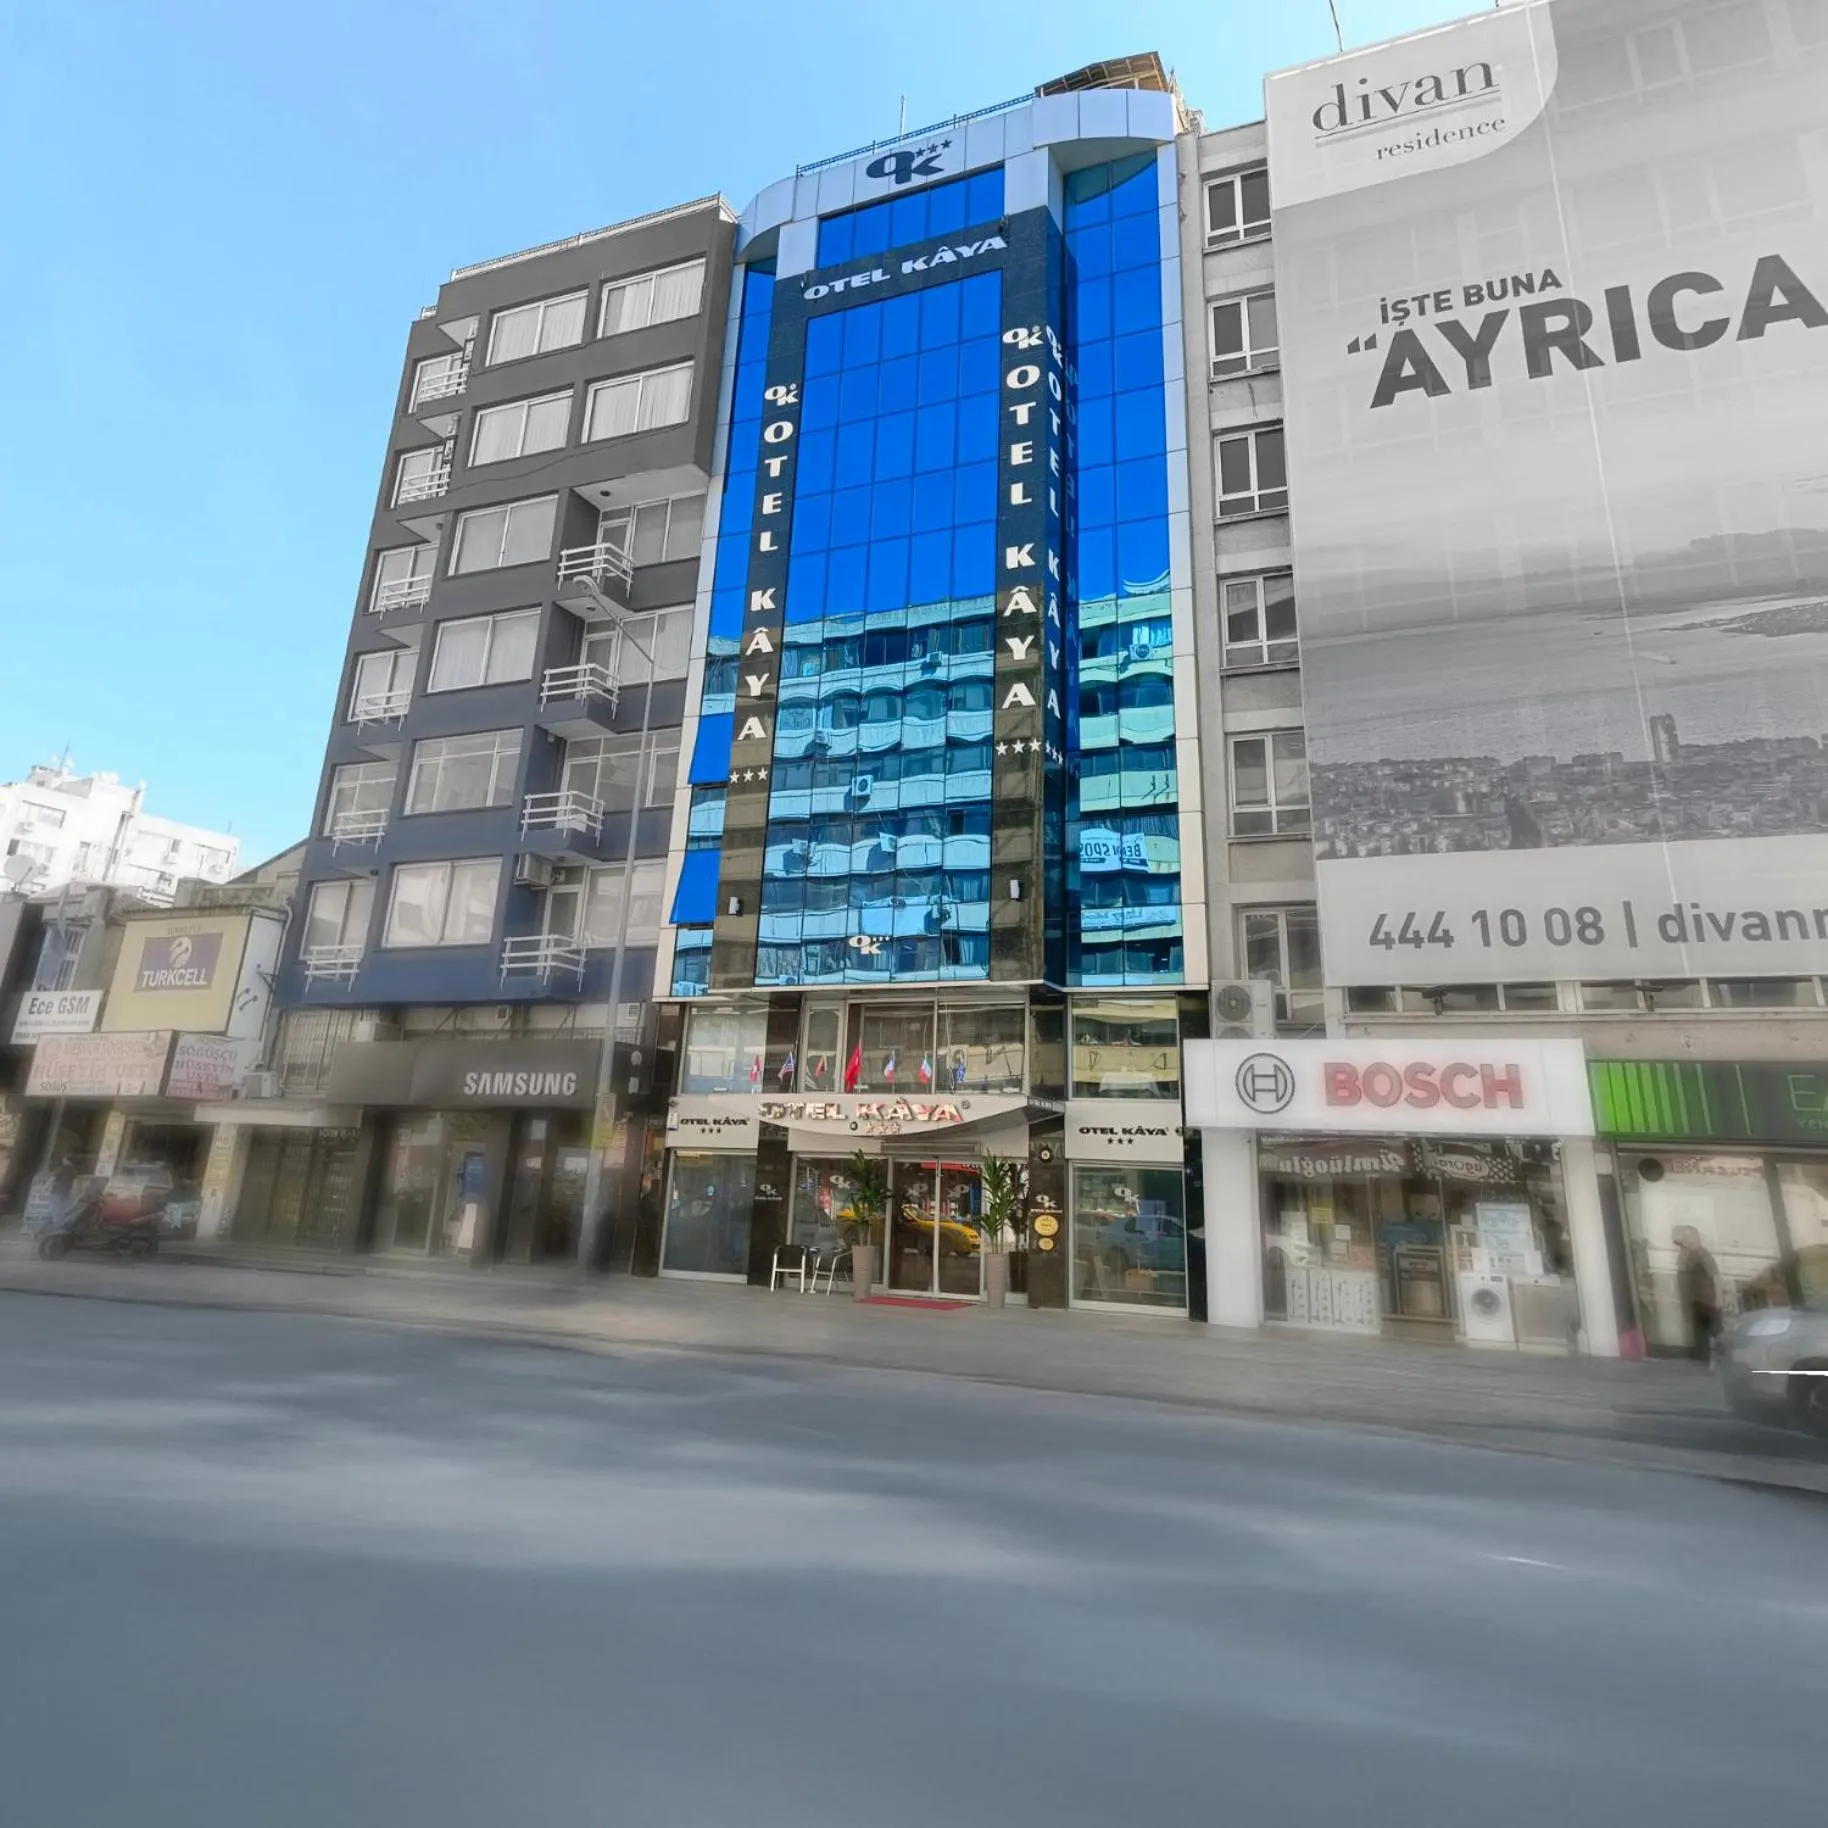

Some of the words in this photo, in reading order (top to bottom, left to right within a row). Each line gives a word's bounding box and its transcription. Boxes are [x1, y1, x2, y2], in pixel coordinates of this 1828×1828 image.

[1312, 61, 1500, 133] divan
[1376, 116, 1506, 160] residence
[803, 267, 891, 300] OTEL
[902, 235, 1009, 274] KÂYA
[1380, 290, 1454, 327] İŞTE
[1464, 268, 1563, 307] BUNA
[1006, 364, 1040, 505] OTEL
[760, 420, 794, 552] OTEL
[1002, 542, 1037, 709] KÂYA
[737, 587, 777, 741] KÂYA
[1369, 911, 1455, 950] 444
[1472, 909, 1528, 948] 10
[1544, 906, 1605, 947] 08
[142, 968, 208, 988] TURKCELL
[28, 997, 54, 1015] Ece
[58, 996, 91, 1014] GSM
[464, 1072, 577, 1096] SAMSUNG
[1323, 1062, 1524, 1109] BOSCH
[680, 1118, 710, 1126] OTEL
[758, 1102, 848, 1121] OTEL
[1079, 1127, 1118, 1136] OTEL
